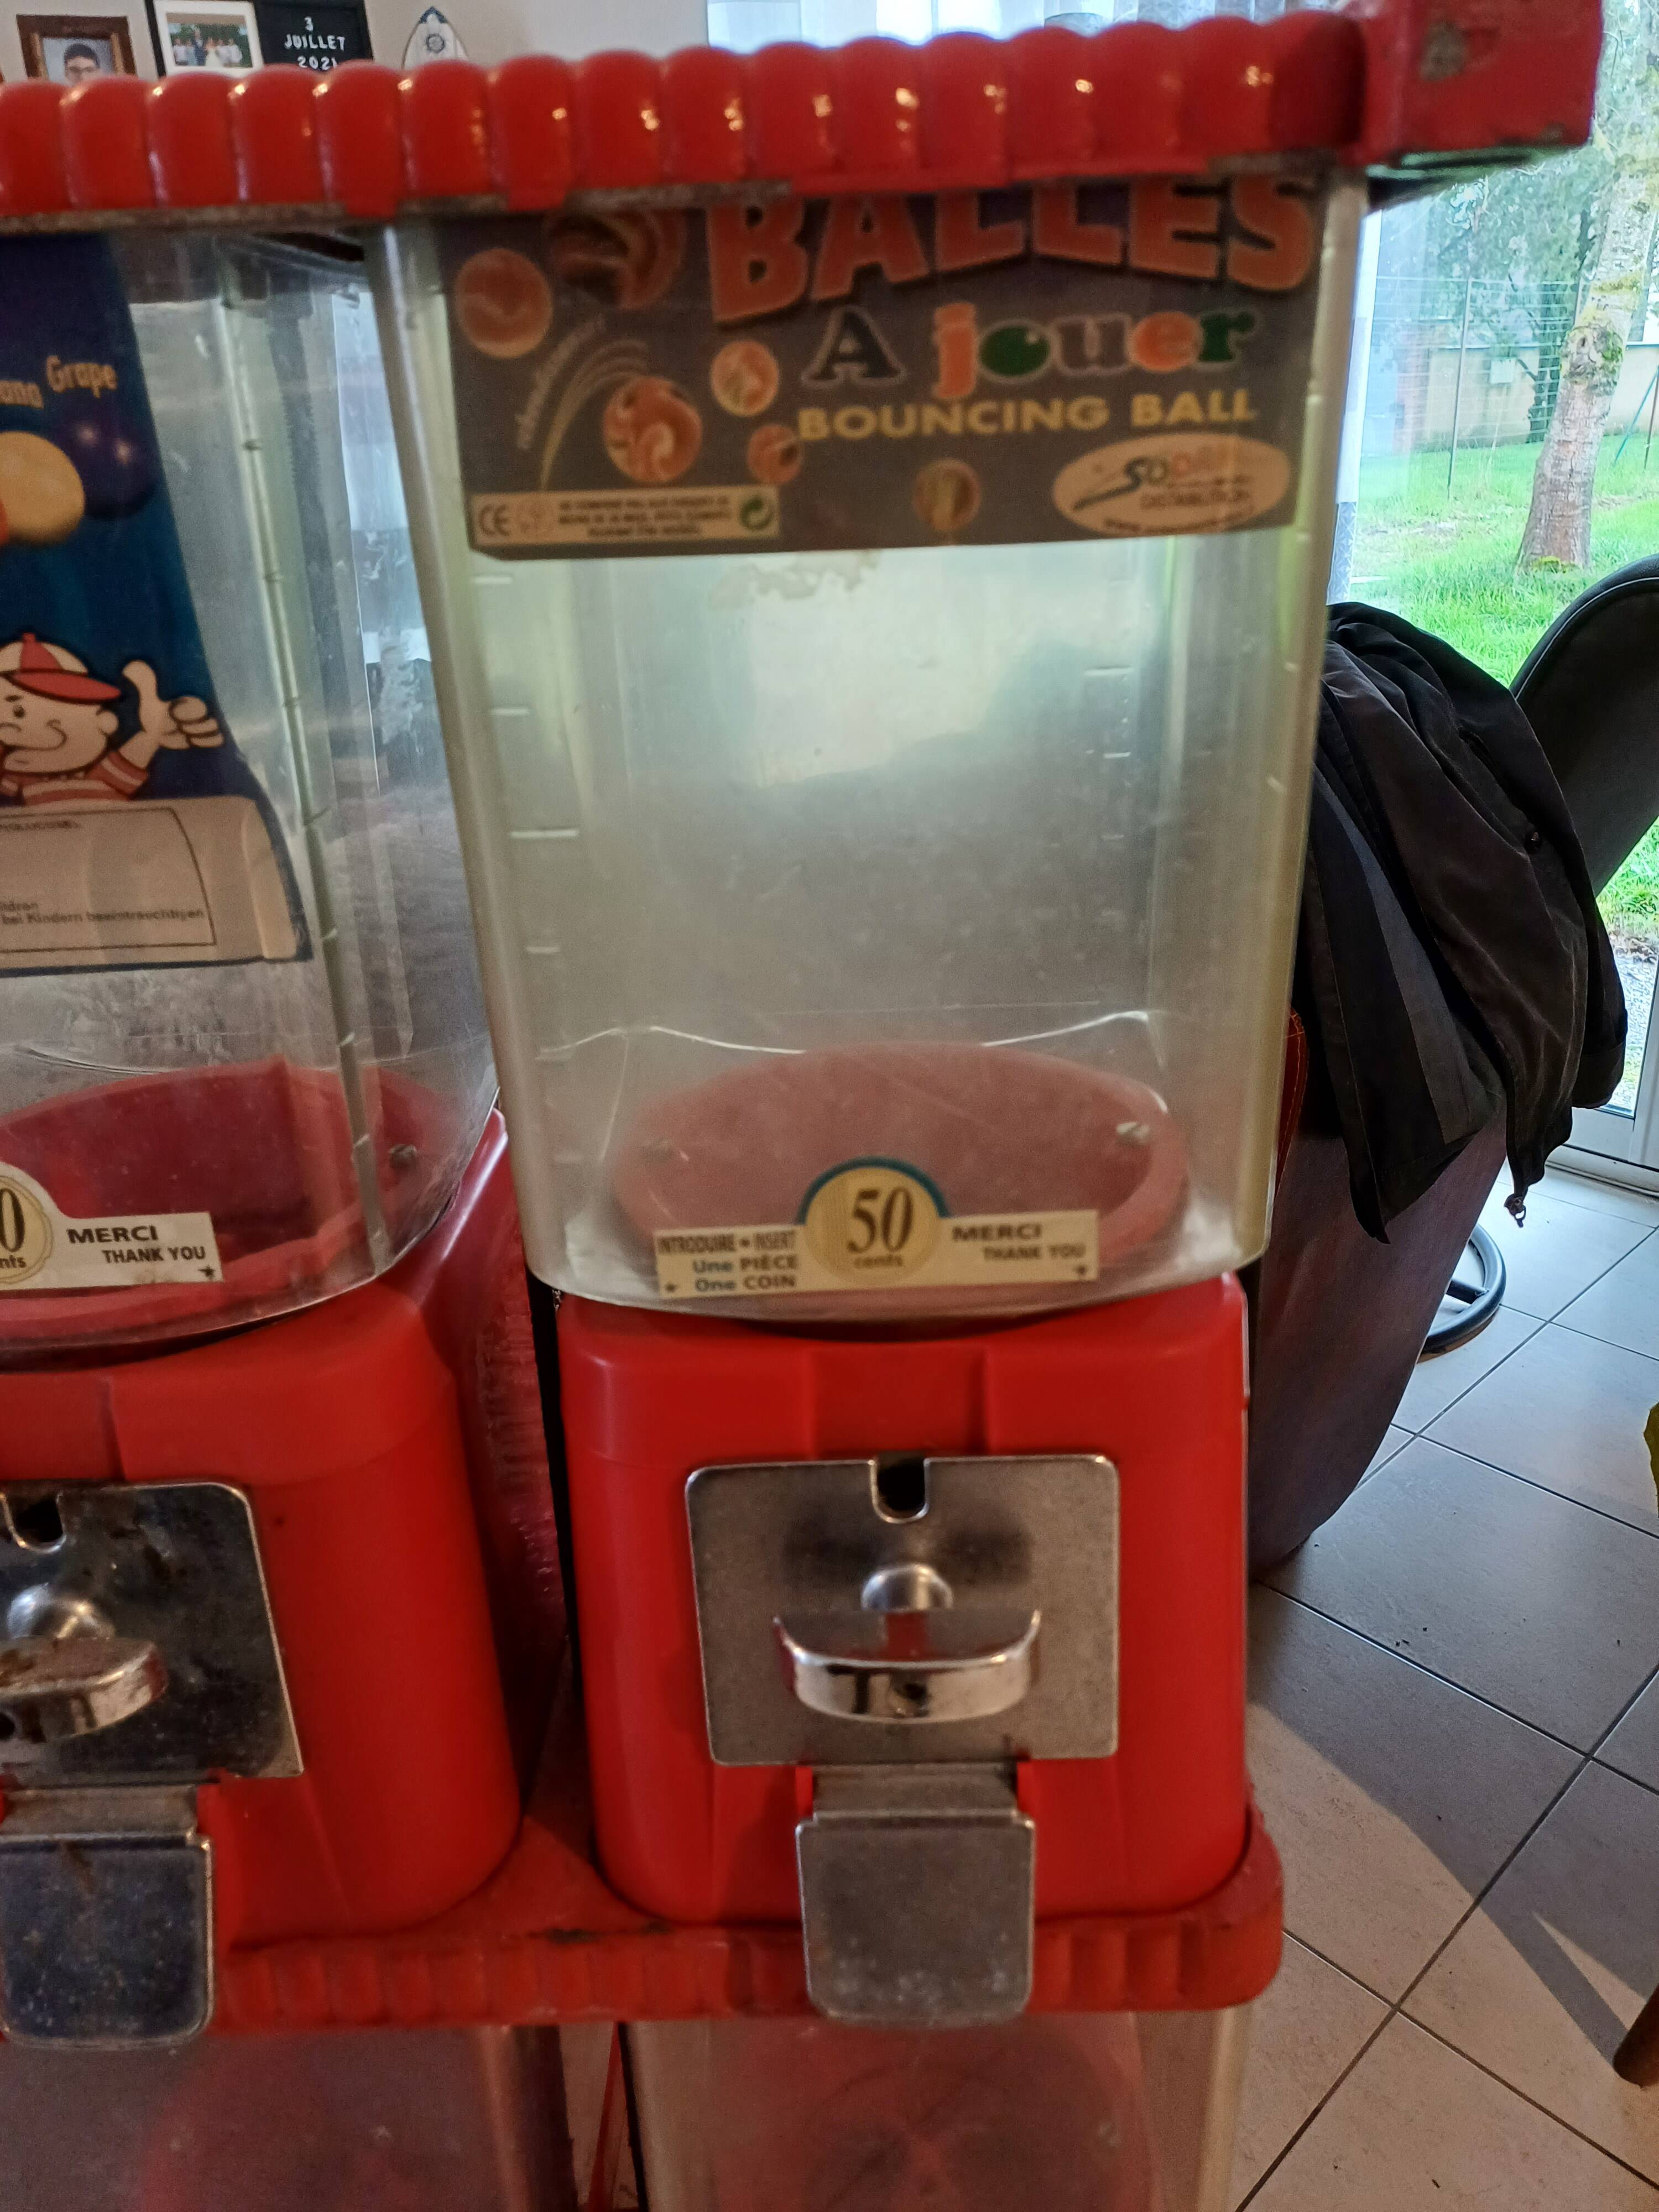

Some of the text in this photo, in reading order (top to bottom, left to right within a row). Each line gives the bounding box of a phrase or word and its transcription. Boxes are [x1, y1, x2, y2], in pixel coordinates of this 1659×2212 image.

[305, 16, 314, 32] 3
[284, 34, 345, 51] JUILLET
[298, 56, 337, 70] 2021
[706, 175, 1316, 324] BALLES
[802, 305, 906, 388] A
[46, 355, 117, 399] Grape
[798, 389, 1259, 441] BOUNCING BALL
[847, 1186, 913, 1253] 50
[66, 1225, 159, 1244] MERCI
[952, 1223, 1042, 1243] MERCI
[102, 1246, 206, 1264] THANK YOU
[983, 1245, 1042, 1261] THANK
[692, 1259, 734, 1274] Une
[695, 1274, 796, 1292] One COIN
